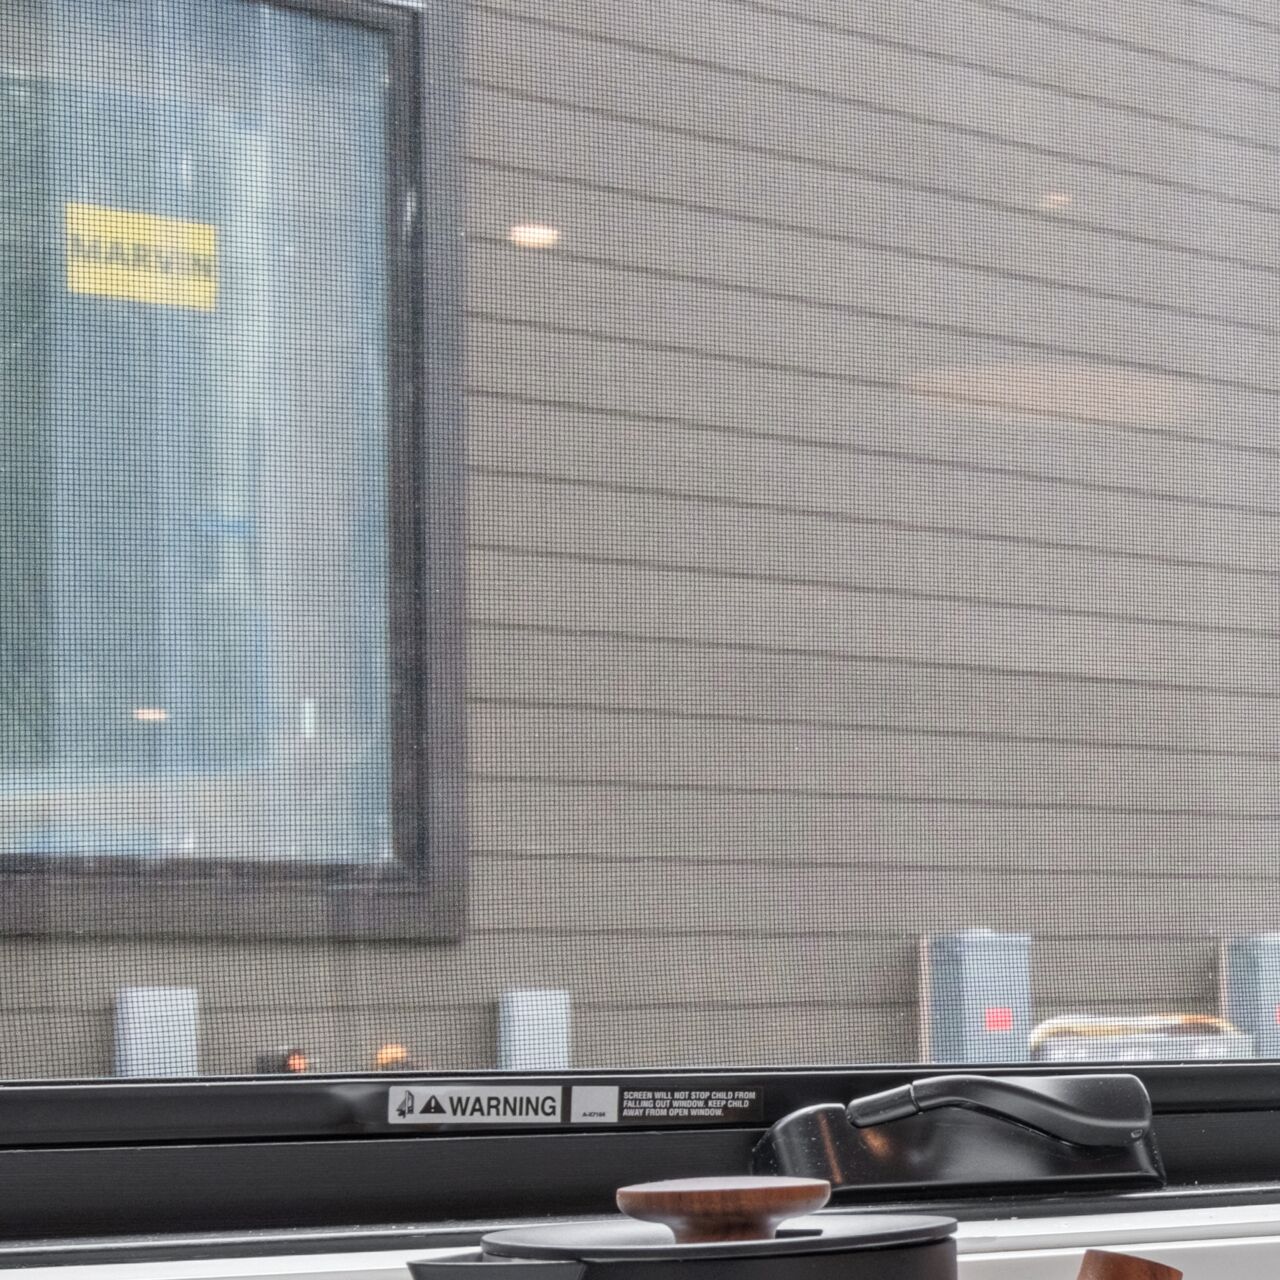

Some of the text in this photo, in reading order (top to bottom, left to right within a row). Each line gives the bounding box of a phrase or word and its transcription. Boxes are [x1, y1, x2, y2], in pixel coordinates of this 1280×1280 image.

[70, 233, 213, 281] MARVN
[623, 1091, 756, 1099] SCREEN WILL NOT STOP CHILD FROM
[449, 1096, 557, 1117] WARNING
[623, 1100, 749, 1108] FALLING OUT WINDOW. KEEP CHILD
[623, 1109, 643, 1117] AWAY
[645, 1109, 667, 1117] FROM
[690, 1108, 724, 1116] WINDOW.
